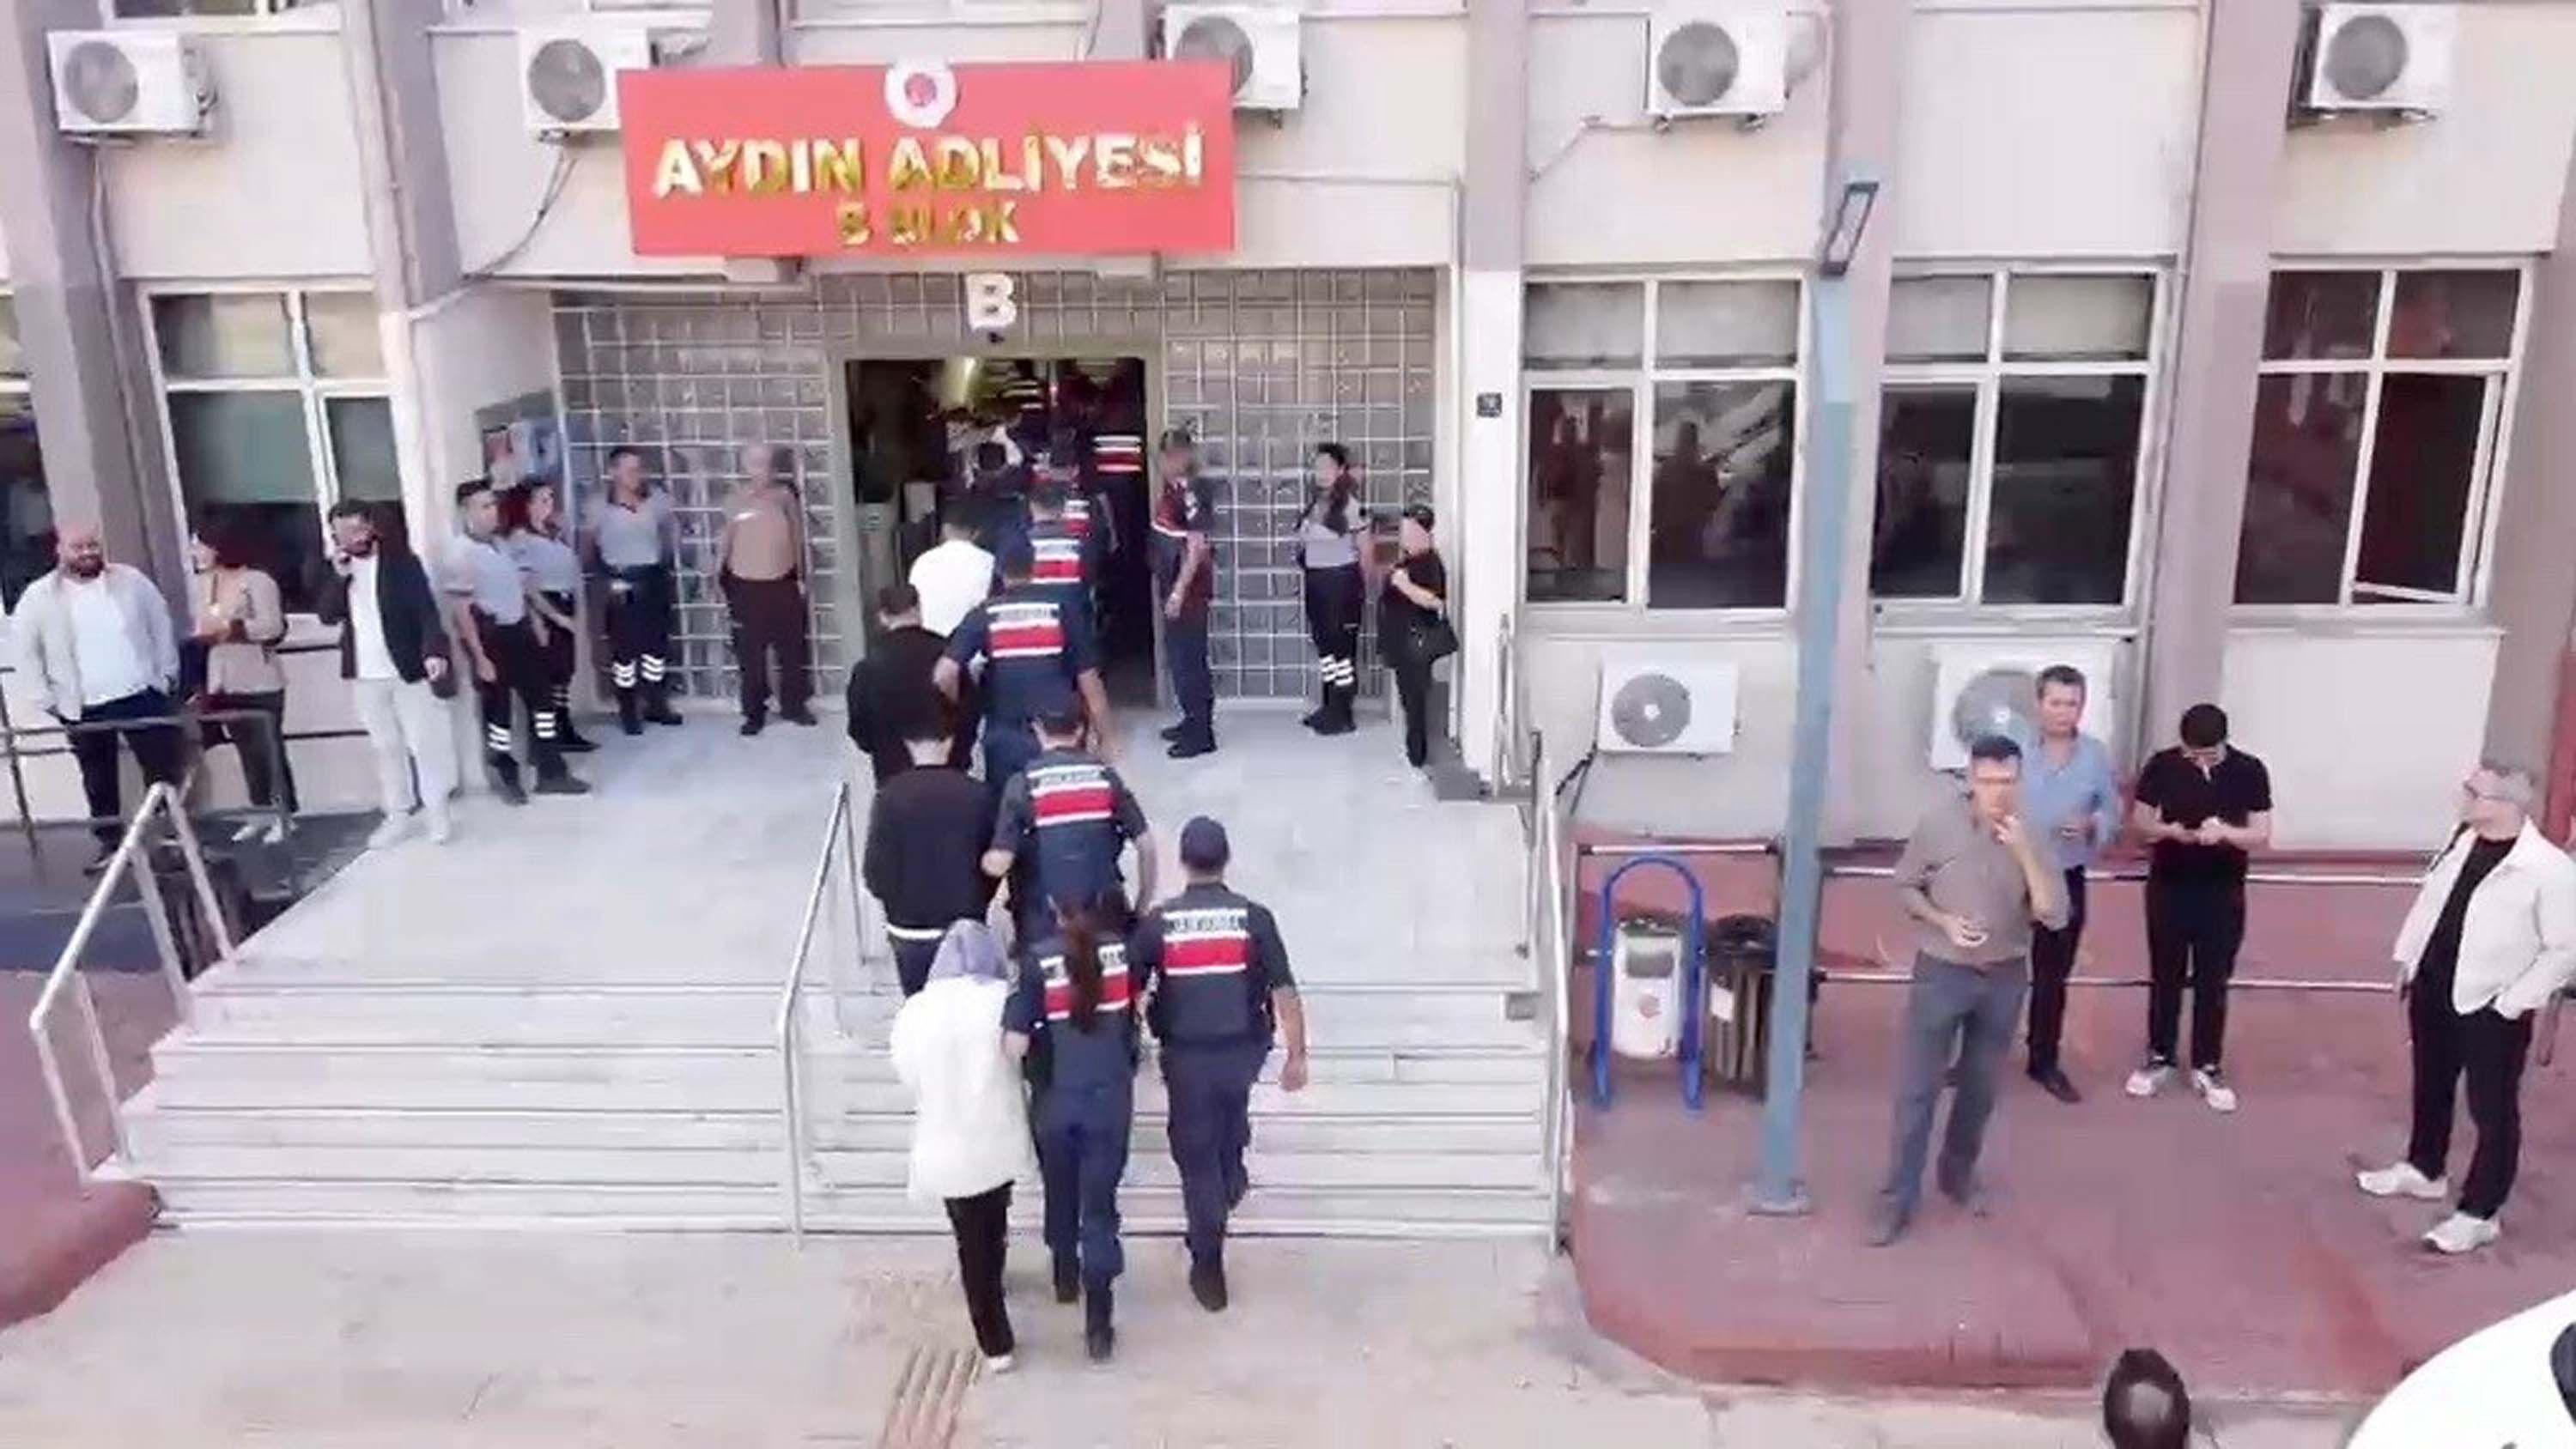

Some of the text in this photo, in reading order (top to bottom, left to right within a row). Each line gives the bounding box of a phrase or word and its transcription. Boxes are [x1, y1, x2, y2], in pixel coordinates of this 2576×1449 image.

[653, 118, 1206, 198] AYDIN ADLİYESİ
[965, 272, 1017, 330] B
